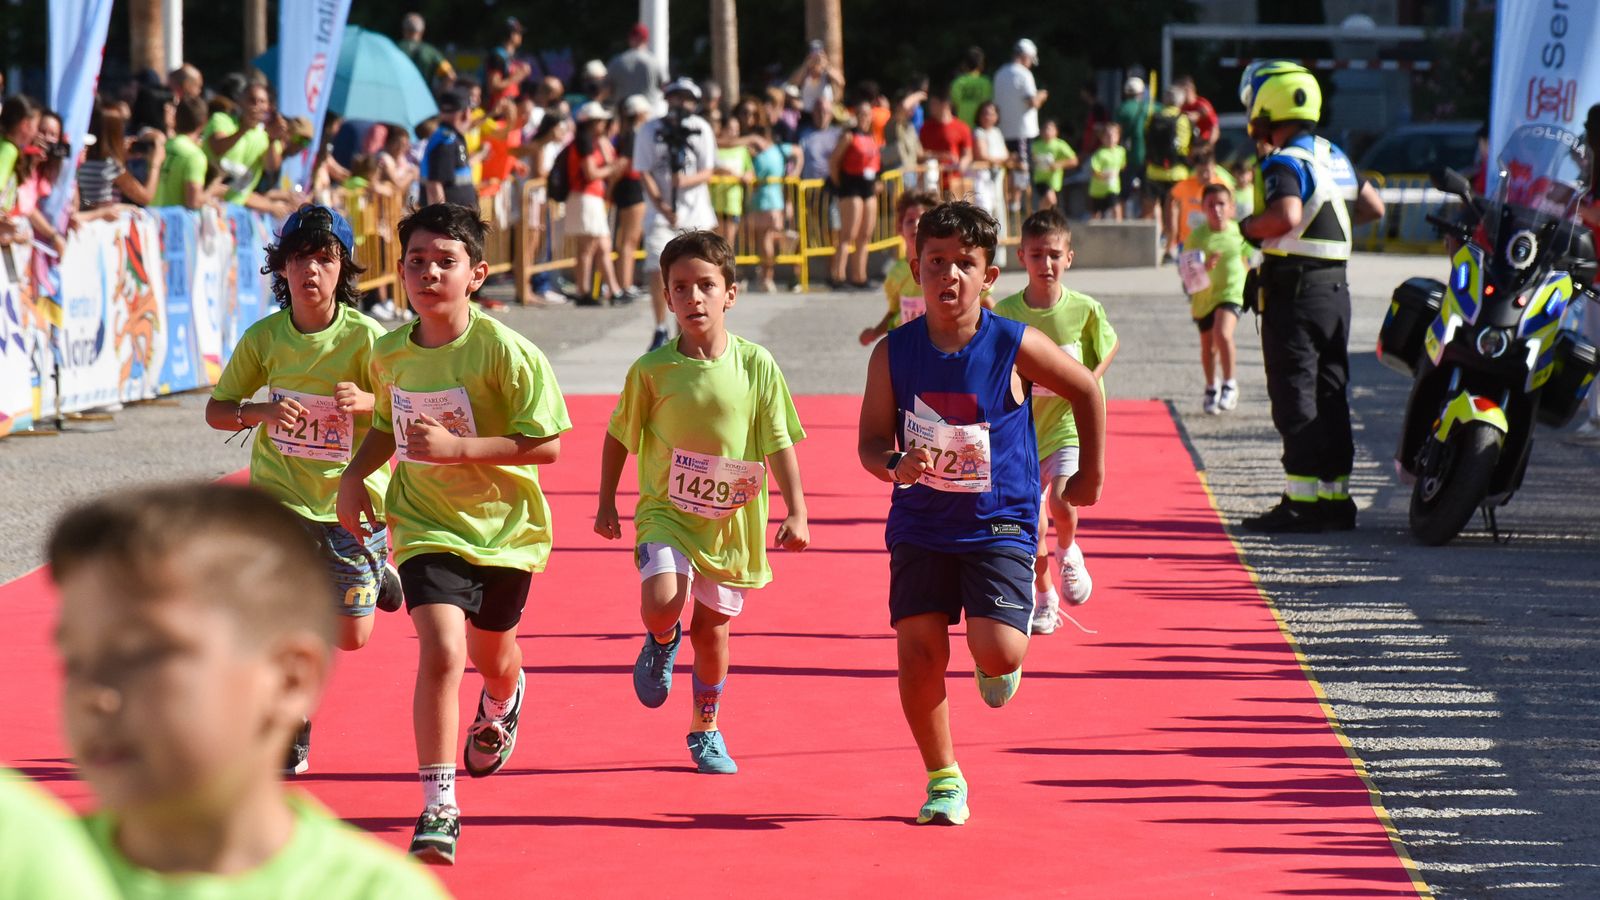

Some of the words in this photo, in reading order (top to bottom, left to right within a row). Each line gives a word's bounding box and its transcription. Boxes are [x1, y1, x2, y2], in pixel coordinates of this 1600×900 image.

[1444, 313, 1463, 345] 1
[1525, 338, 1542, 371] 1
[675, 454, 691, 467] XXI
[909, 439, 957, 473] 72
[675, 472, 730, 503] 1429
